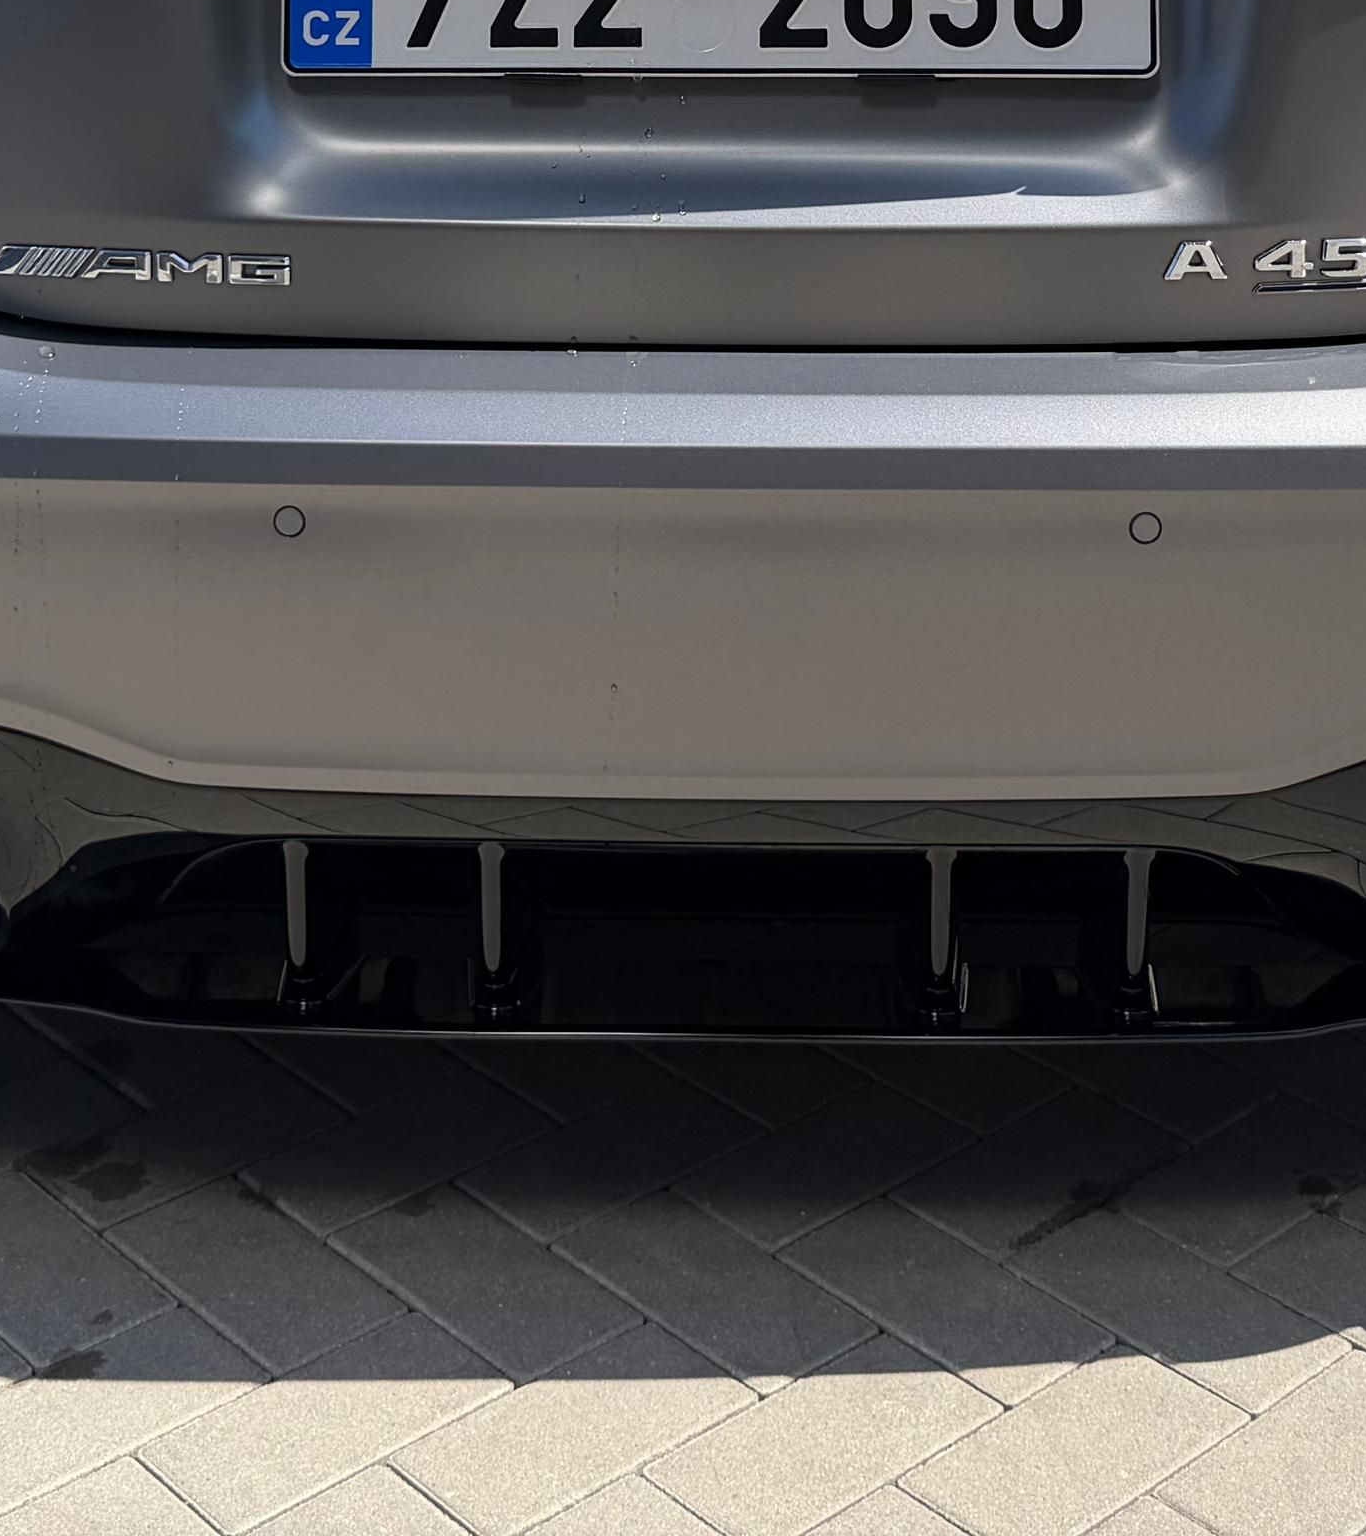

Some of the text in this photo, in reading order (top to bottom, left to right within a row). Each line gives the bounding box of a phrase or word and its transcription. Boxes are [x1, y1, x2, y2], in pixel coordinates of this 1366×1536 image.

[302, 9, 361, 47] CZ
[81, 247, 291, 286] AMG
[1164, 239, 1228, 281] A
